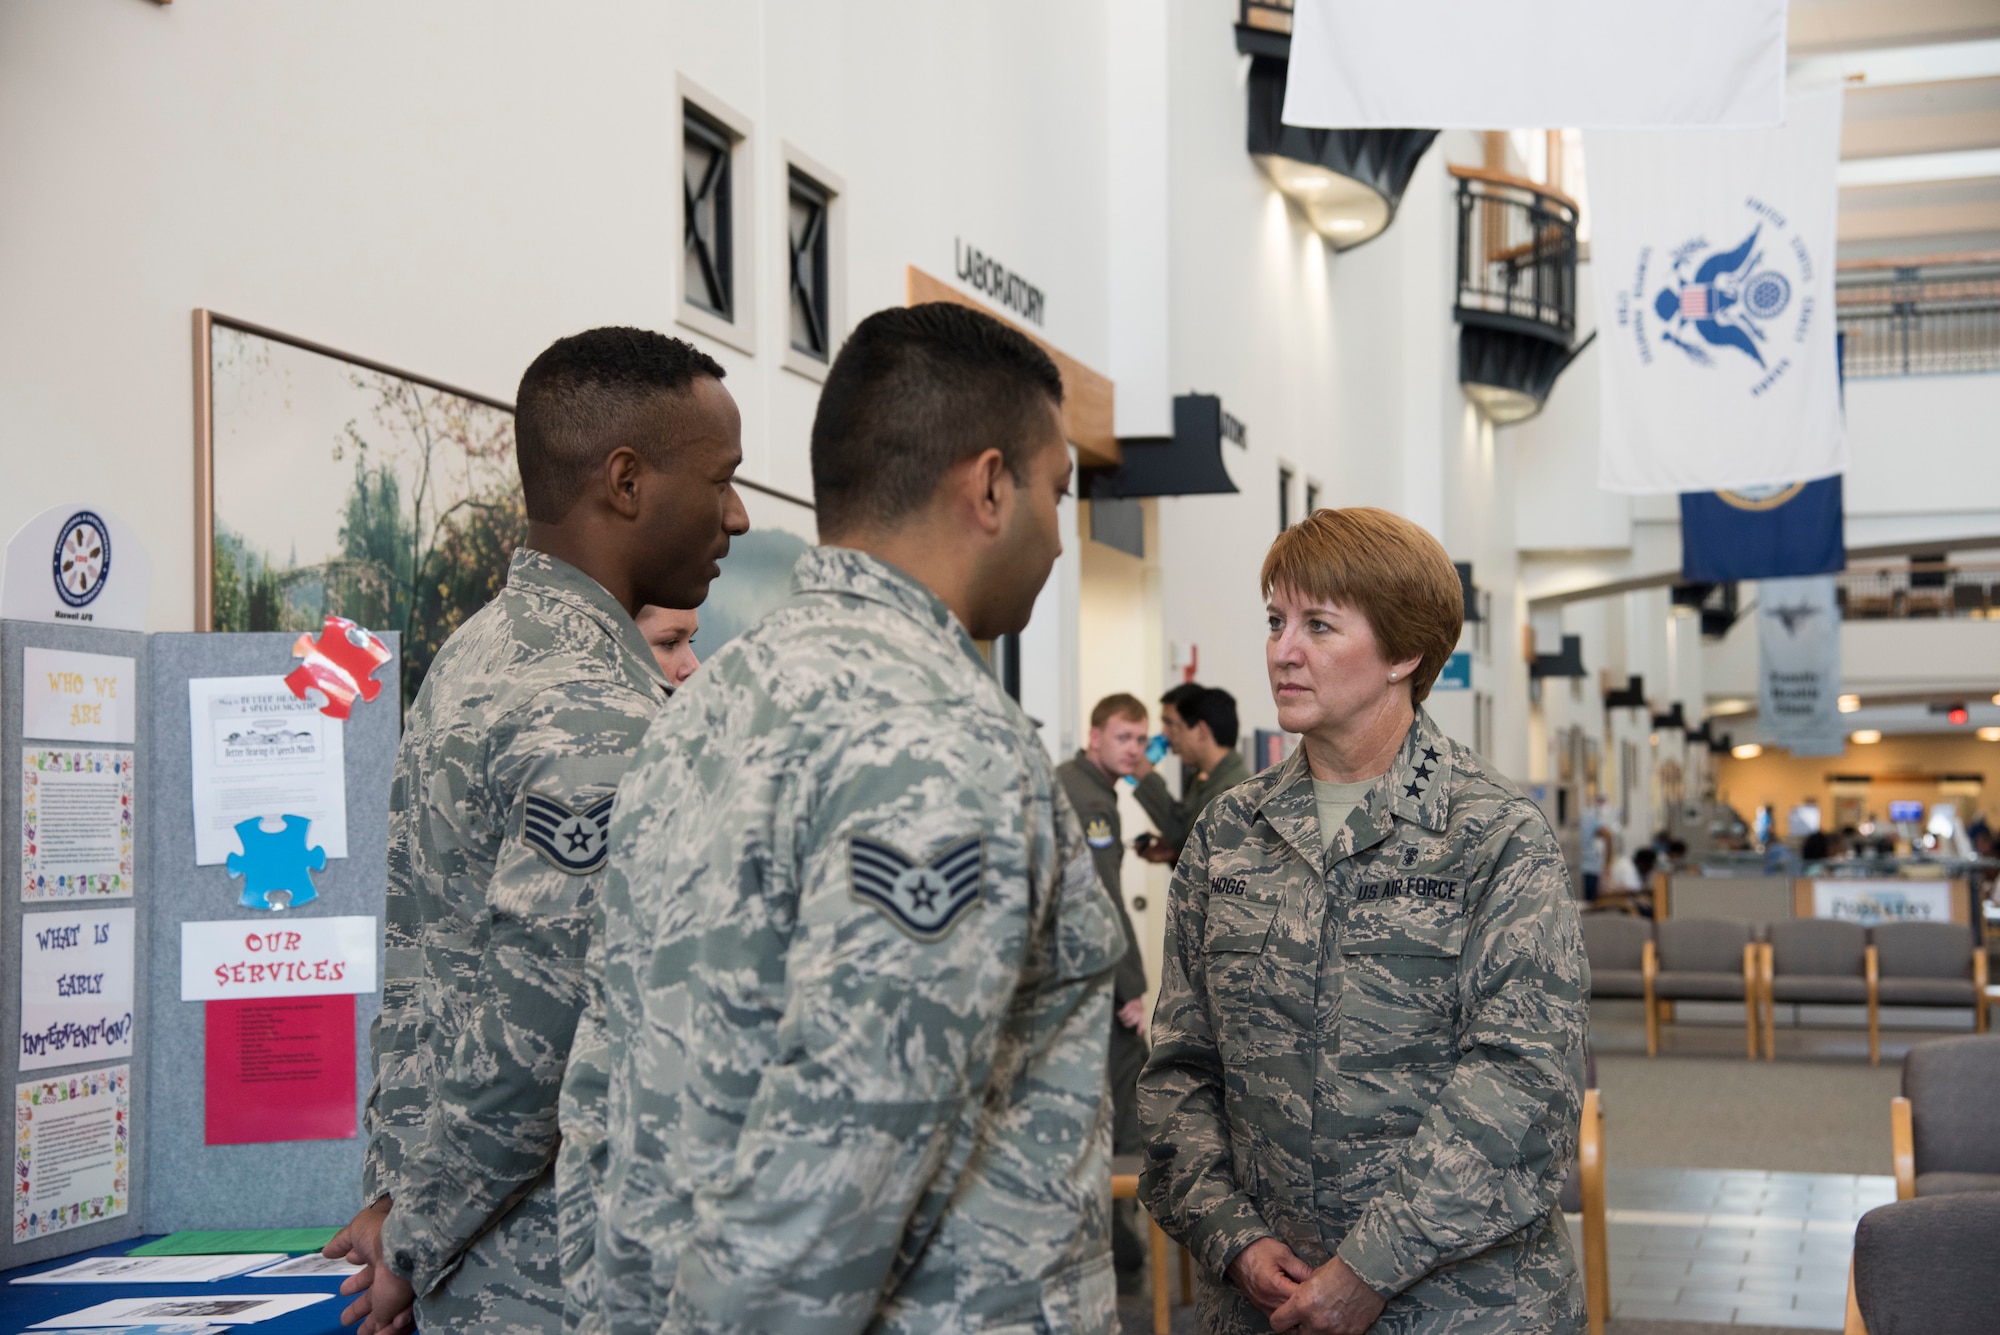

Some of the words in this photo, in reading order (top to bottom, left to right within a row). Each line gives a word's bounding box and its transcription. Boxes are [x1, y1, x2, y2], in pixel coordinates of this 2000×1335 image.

[955, 236, 1045, 326] LABORATORY
[55, 610, 79, 620] Maxwell
[48, 672, 84, 694] WHO
[94, 677, 117, 699] WE
[70, 704, 102, 726] ARE
[1210, 877, 1247, 896] HOGG
[1381, 880, 1402, 899] AIR
[1405, 877, 1458, 899] FORCE
[36, 924, 80, 951] WHAT
[93, 923, 110, 945] IS
[245, 932, 302, 953] OUR
[57, 973, 104, 997] EARLY
[214, 960, 346, 988] SERVICES
[22, 1012, 132, 1057] INTERVENTION?
